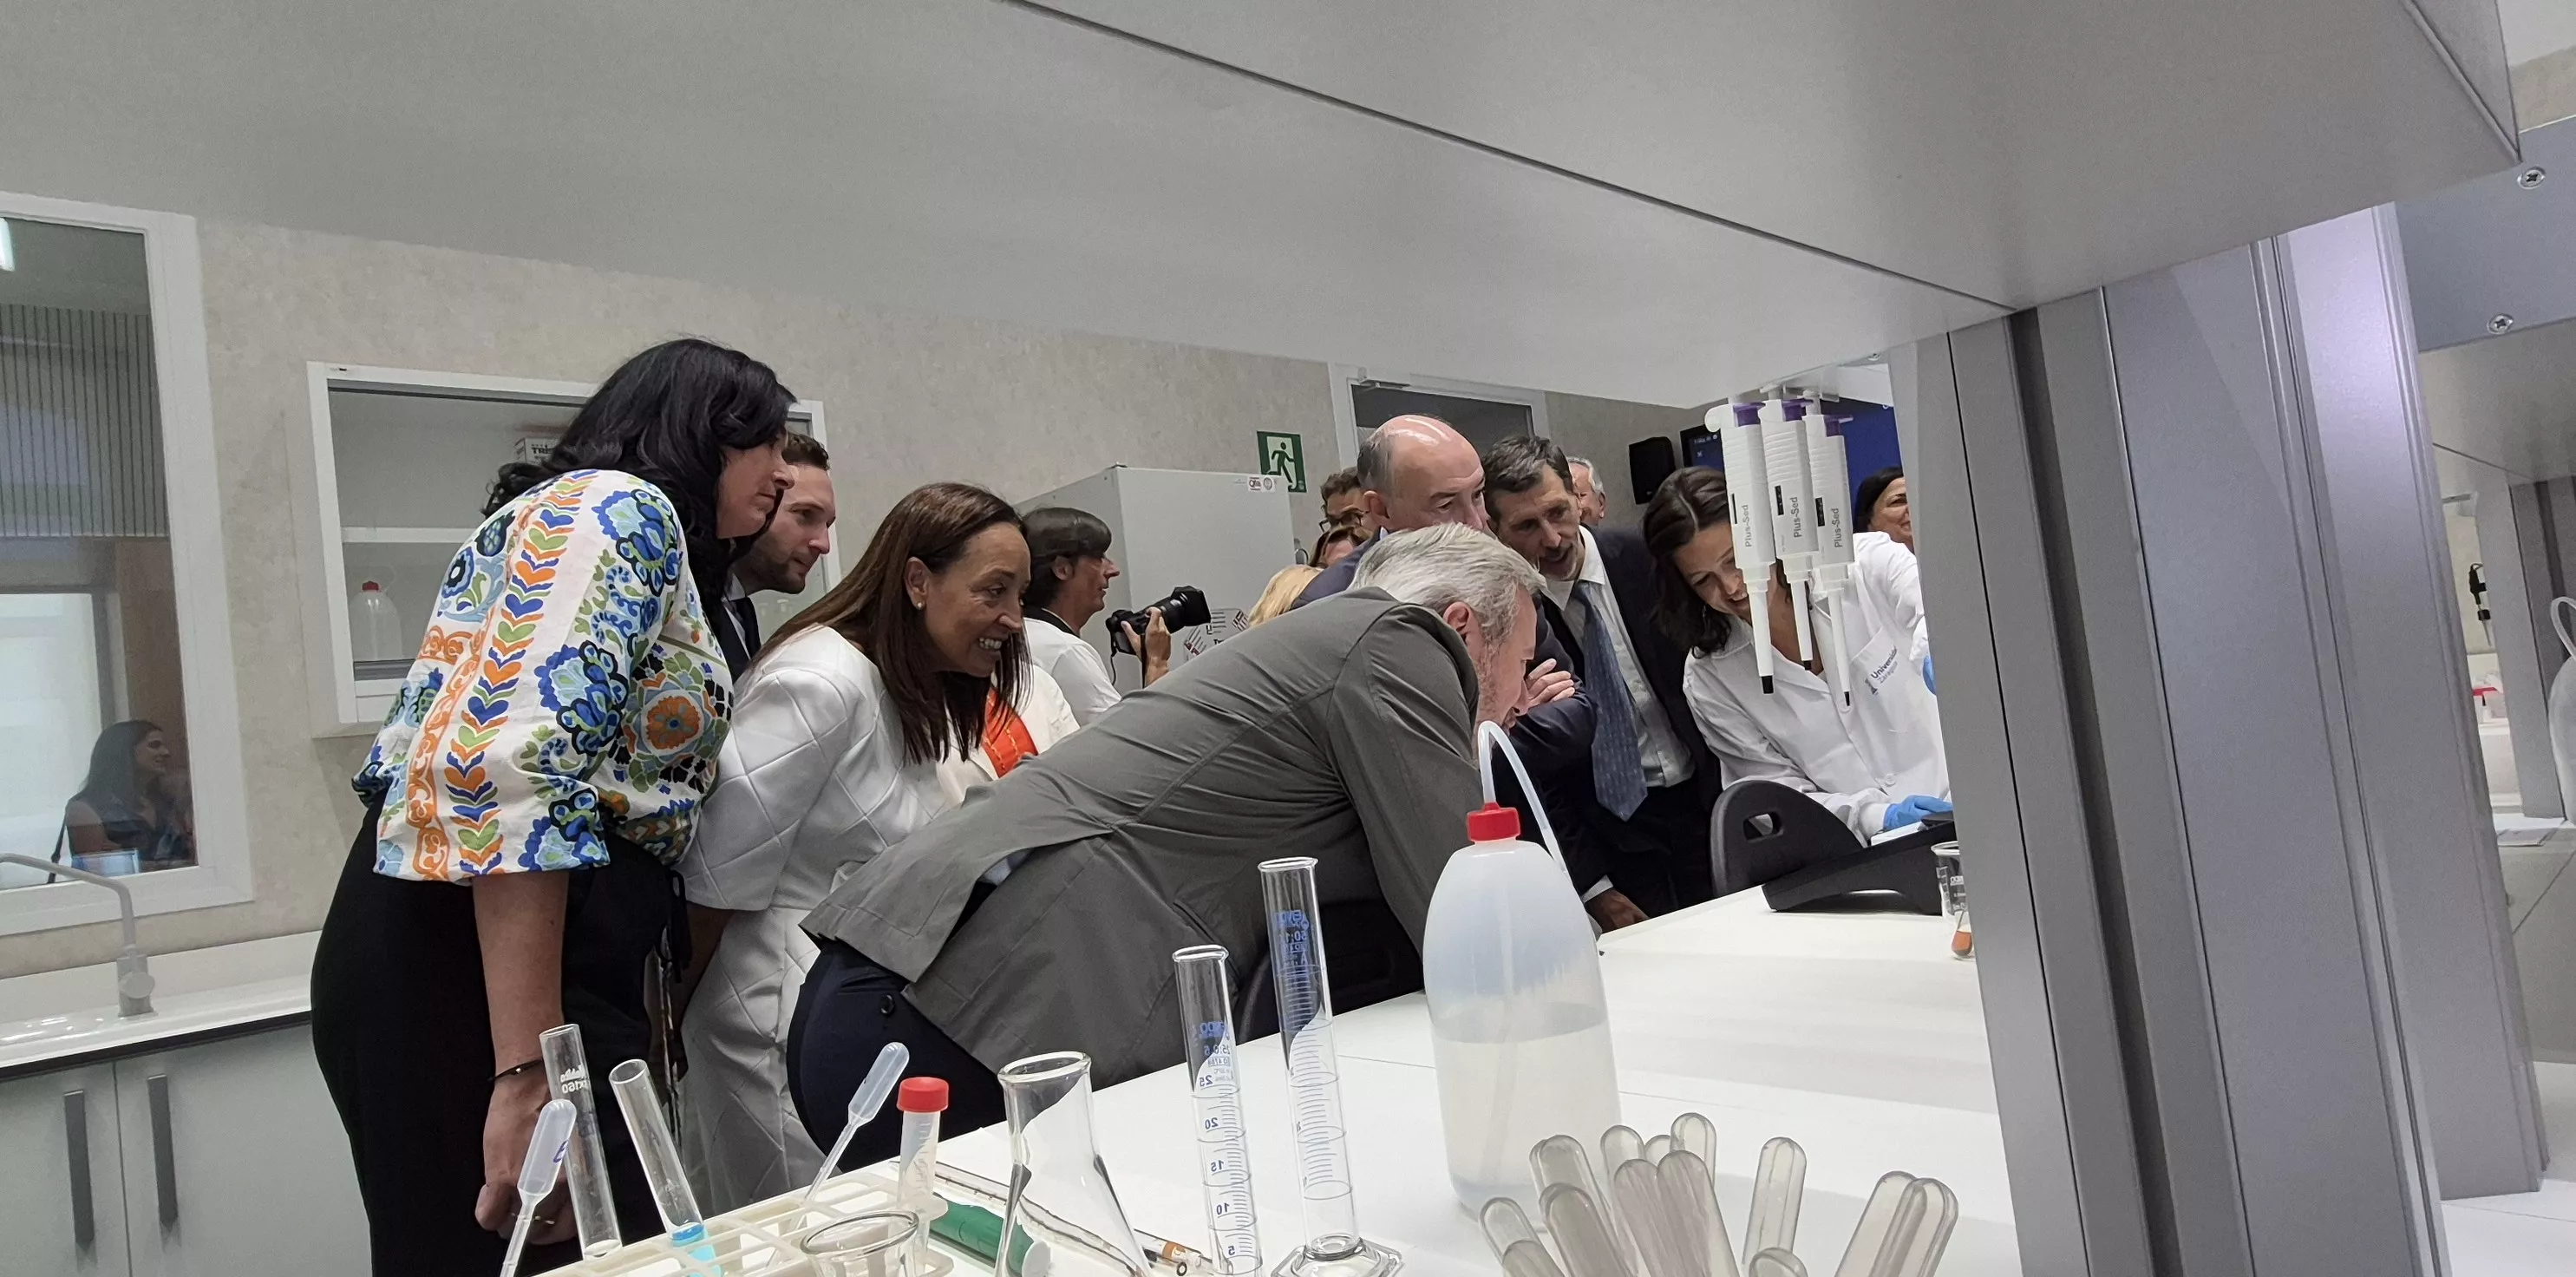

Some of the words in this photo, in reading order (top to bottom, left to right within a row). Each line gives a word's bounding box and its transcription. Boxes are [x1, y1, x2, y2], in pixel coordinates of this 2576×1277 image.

[1742, 504, 1752, 547] Plus-Sed
[1790, 496, 1802, 539] Plus-Sed
[1830, 508, 1842, 548] Plus-Sed
